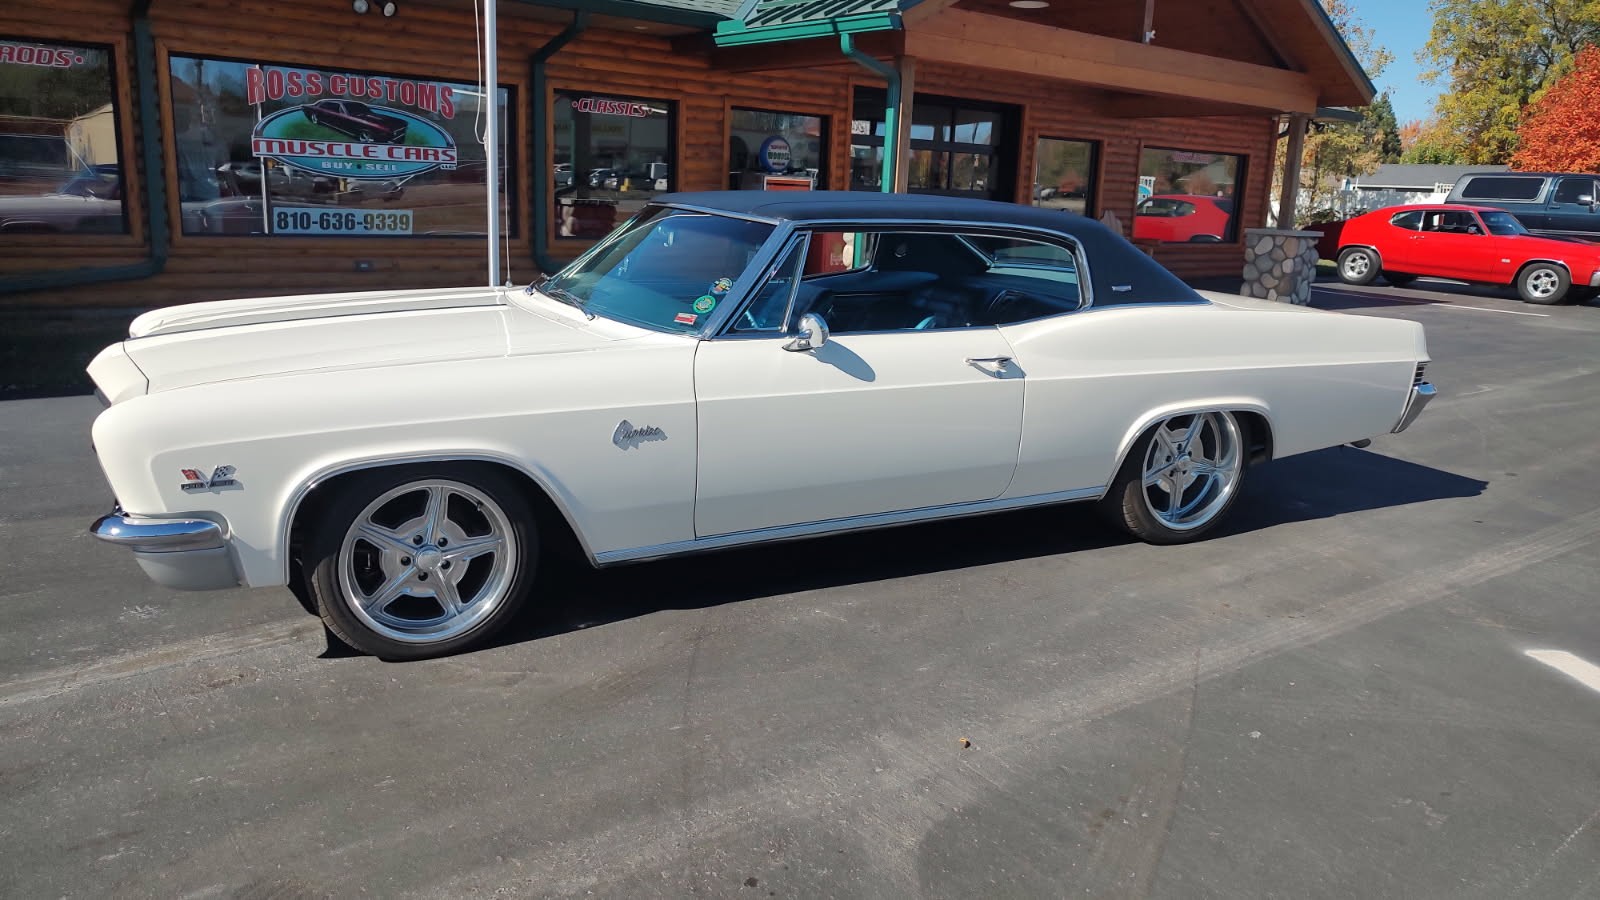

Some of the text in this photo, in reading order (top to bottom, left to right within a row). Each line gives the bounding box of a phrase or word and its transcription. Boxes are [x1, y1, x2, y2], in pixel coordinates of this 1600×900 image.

[0, 44, 73, 68] RODS
[246, 67, 455, 119] ROSS CUSTOMS
[578, 98, 648, 118] CLASSICS
[253, 139, 456, 163] MUSCLE CARS
[321, 161, 397, 171] BUY SELL
[276, 211, 410, 231] 810-636-9339
